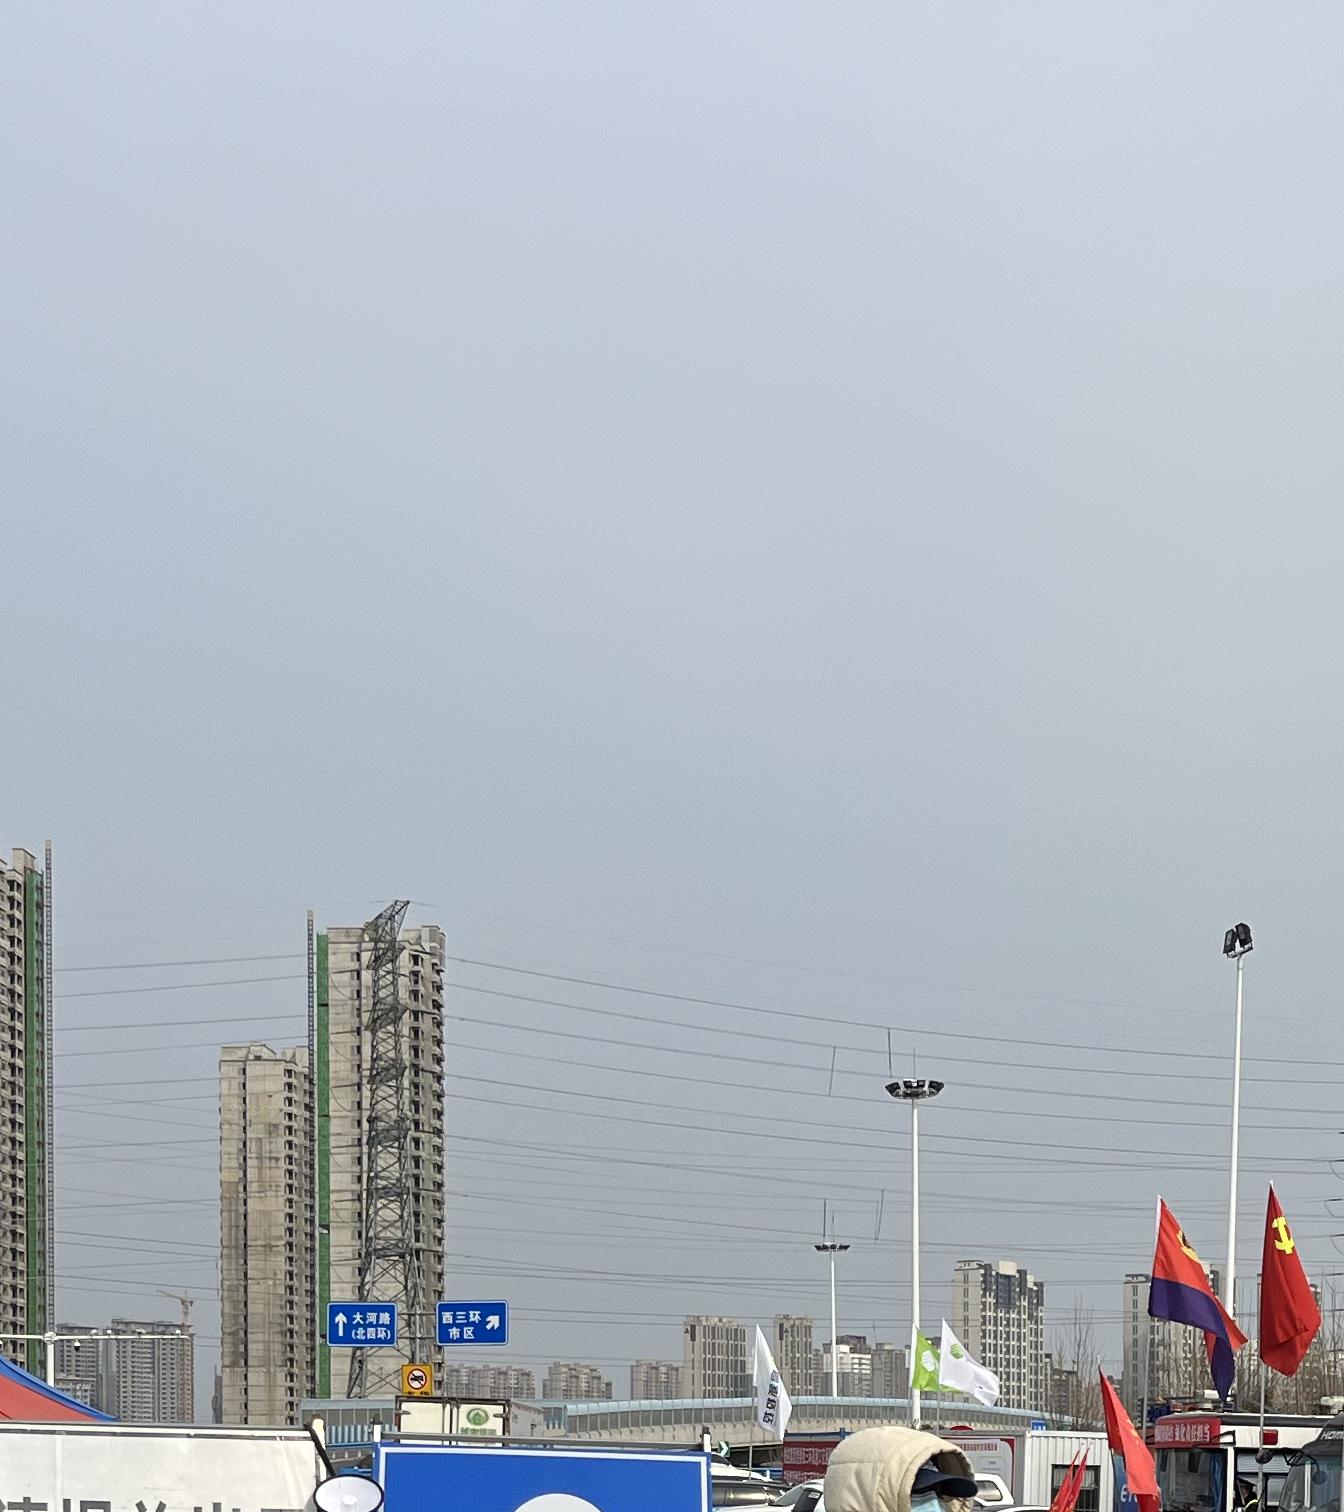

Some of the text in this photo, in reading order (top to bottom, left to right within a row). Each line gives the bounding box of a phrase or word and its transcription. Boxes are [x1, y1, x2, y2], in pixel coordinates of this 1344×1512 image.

[352, 1312, 391, 1325] 大河路
[442, 1311, 481, 1325] 西三环
[448, 1327, 475, 1340] 市区
